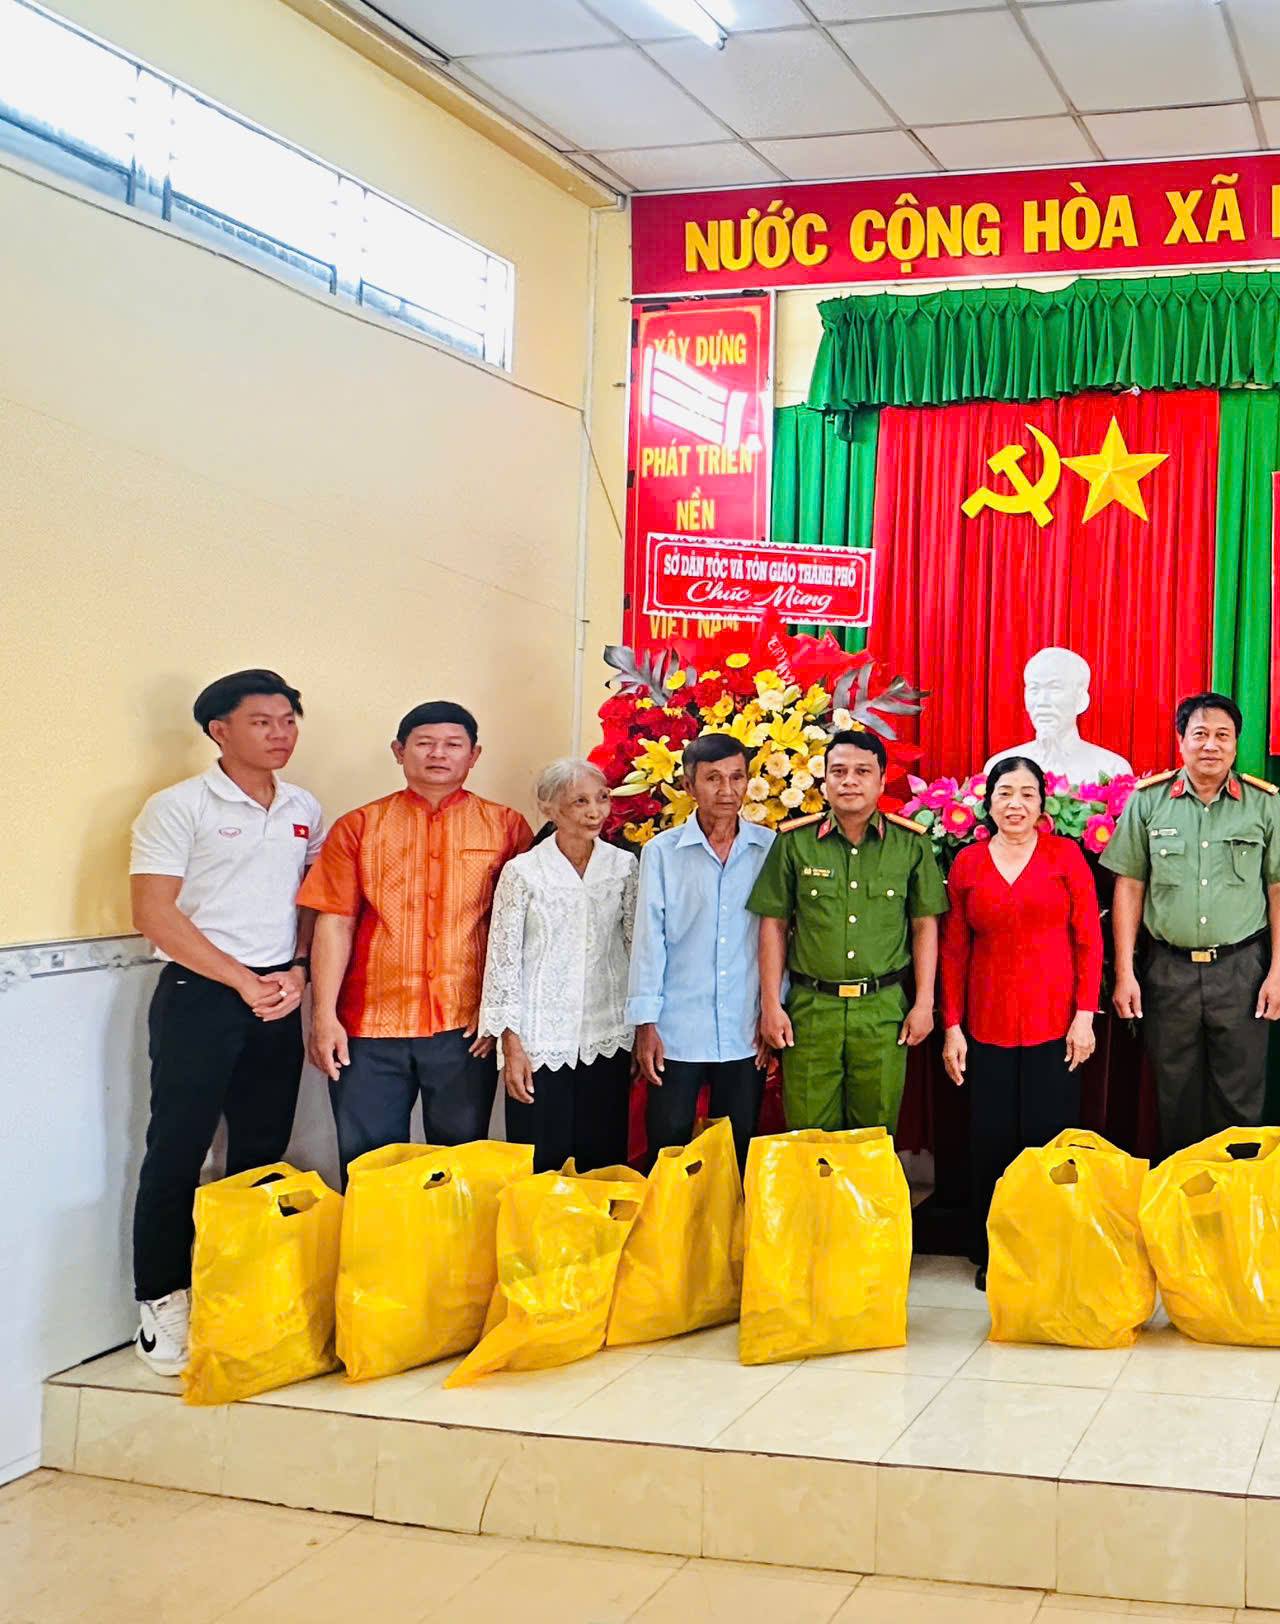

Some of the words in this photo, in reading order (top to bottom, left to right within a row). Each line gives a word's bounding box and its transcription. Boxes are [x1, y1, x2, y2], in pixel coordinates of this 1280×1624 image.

[685, 199, 829, 272] NƯỚC
[850, 192, 1001, 274] CỘNG
[1023, 181, 1139, 254] HÒA
[1163, 172, 1246, 245] XÃ
[695, 329, 748, 373] DỰNG
[641, 438, 691, 478] PHÁT
[676, 486, 715, 531] NỀN
[664, 548, 681, 576] SỞ
[681, 550, 705, 577] DÂN
[706, 552, 729, 582] TỘC
[730, 553, 745, 579] VÀ
[746, 557, 768, 581] TÔN
[769, 557, 797, 583] GIÁO
[798, 558, 834, 586] THÀNH
[835, 563, 857, 588] PHỐ
[687, 580, 751, 603] Chúc
